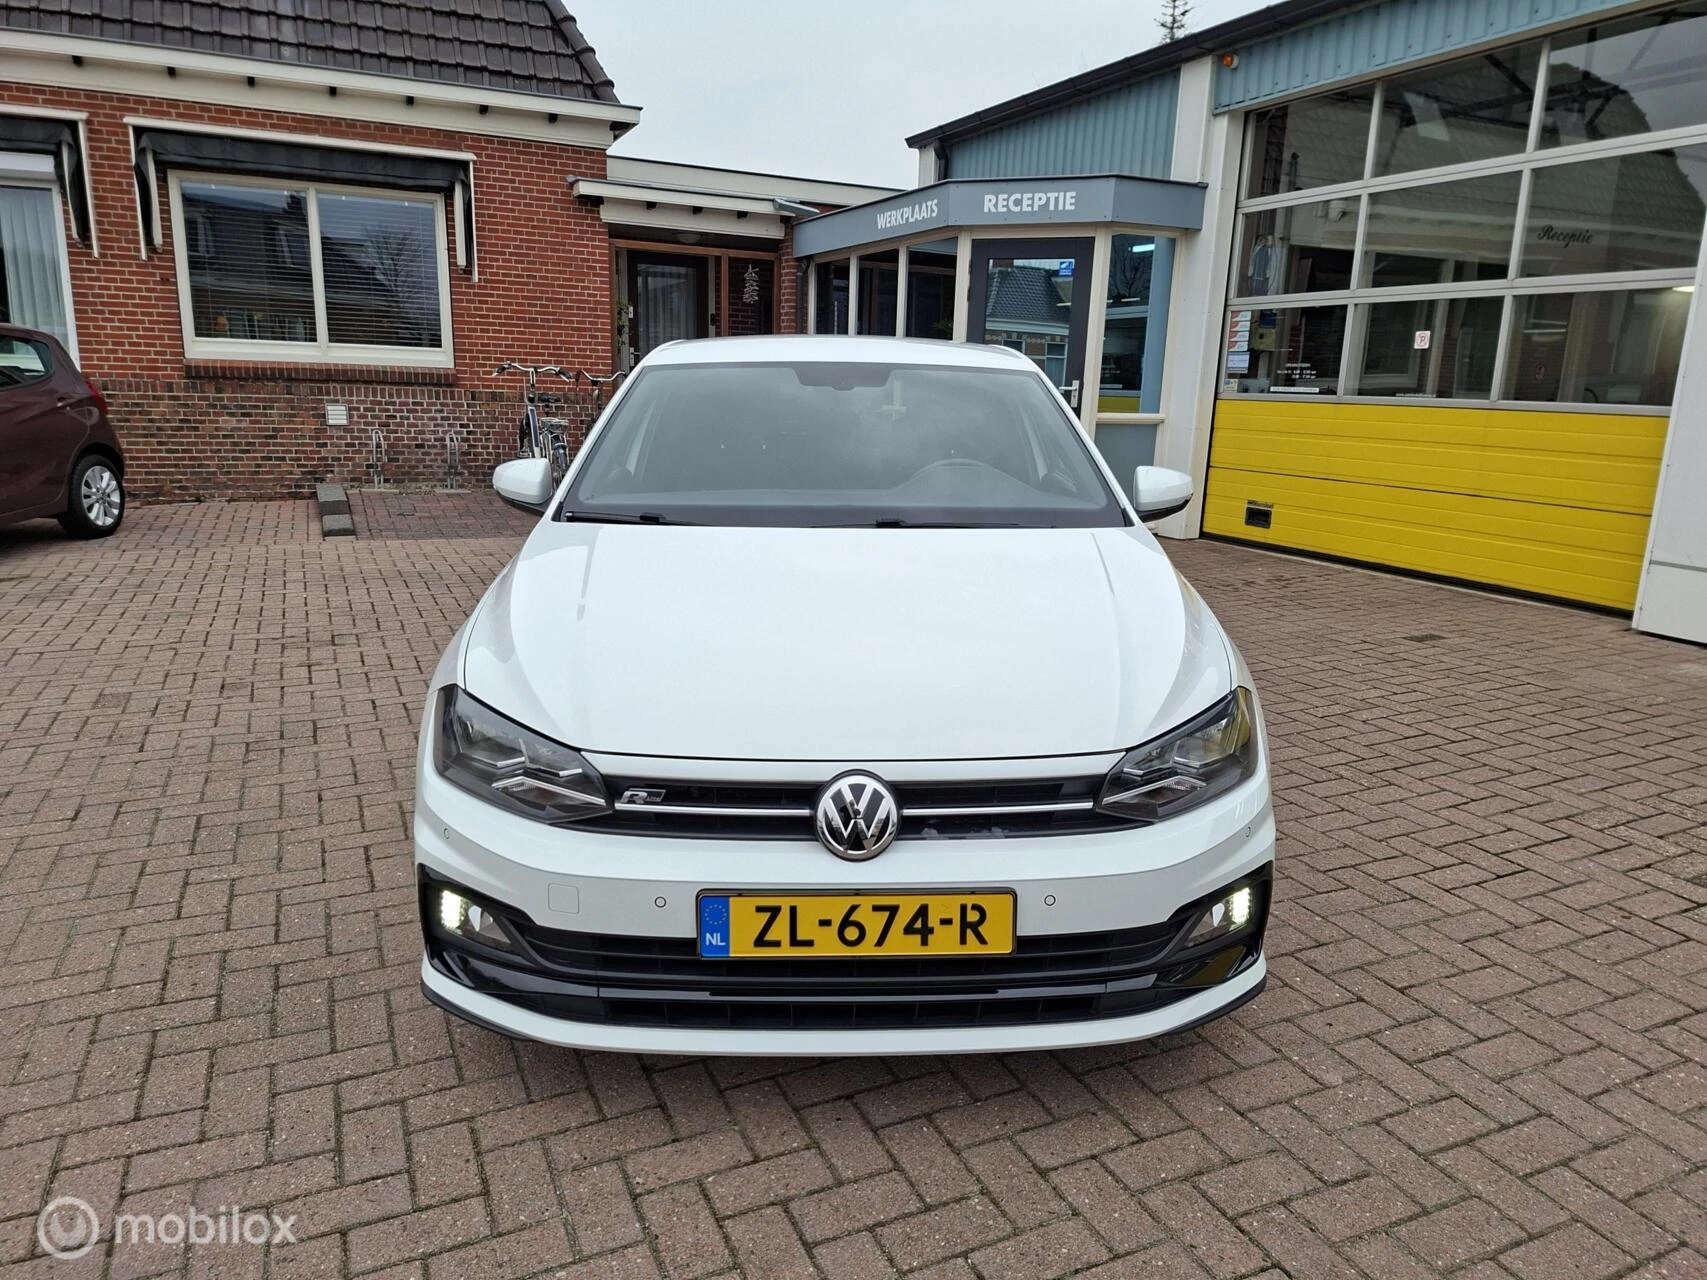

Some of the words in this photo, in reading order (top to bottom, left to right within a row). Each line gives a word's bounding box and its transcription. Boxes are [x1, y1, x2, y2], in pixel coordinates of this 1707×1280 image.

[876, 199, 938, 230] WERKPLAATS
[983, 191, 1077, 213] RECEPTIE
[1536, 223, 1594, 249] Receptie
[752, 903, 989, 948] ZL-674-R
[705, 932, 727, 946] NL
